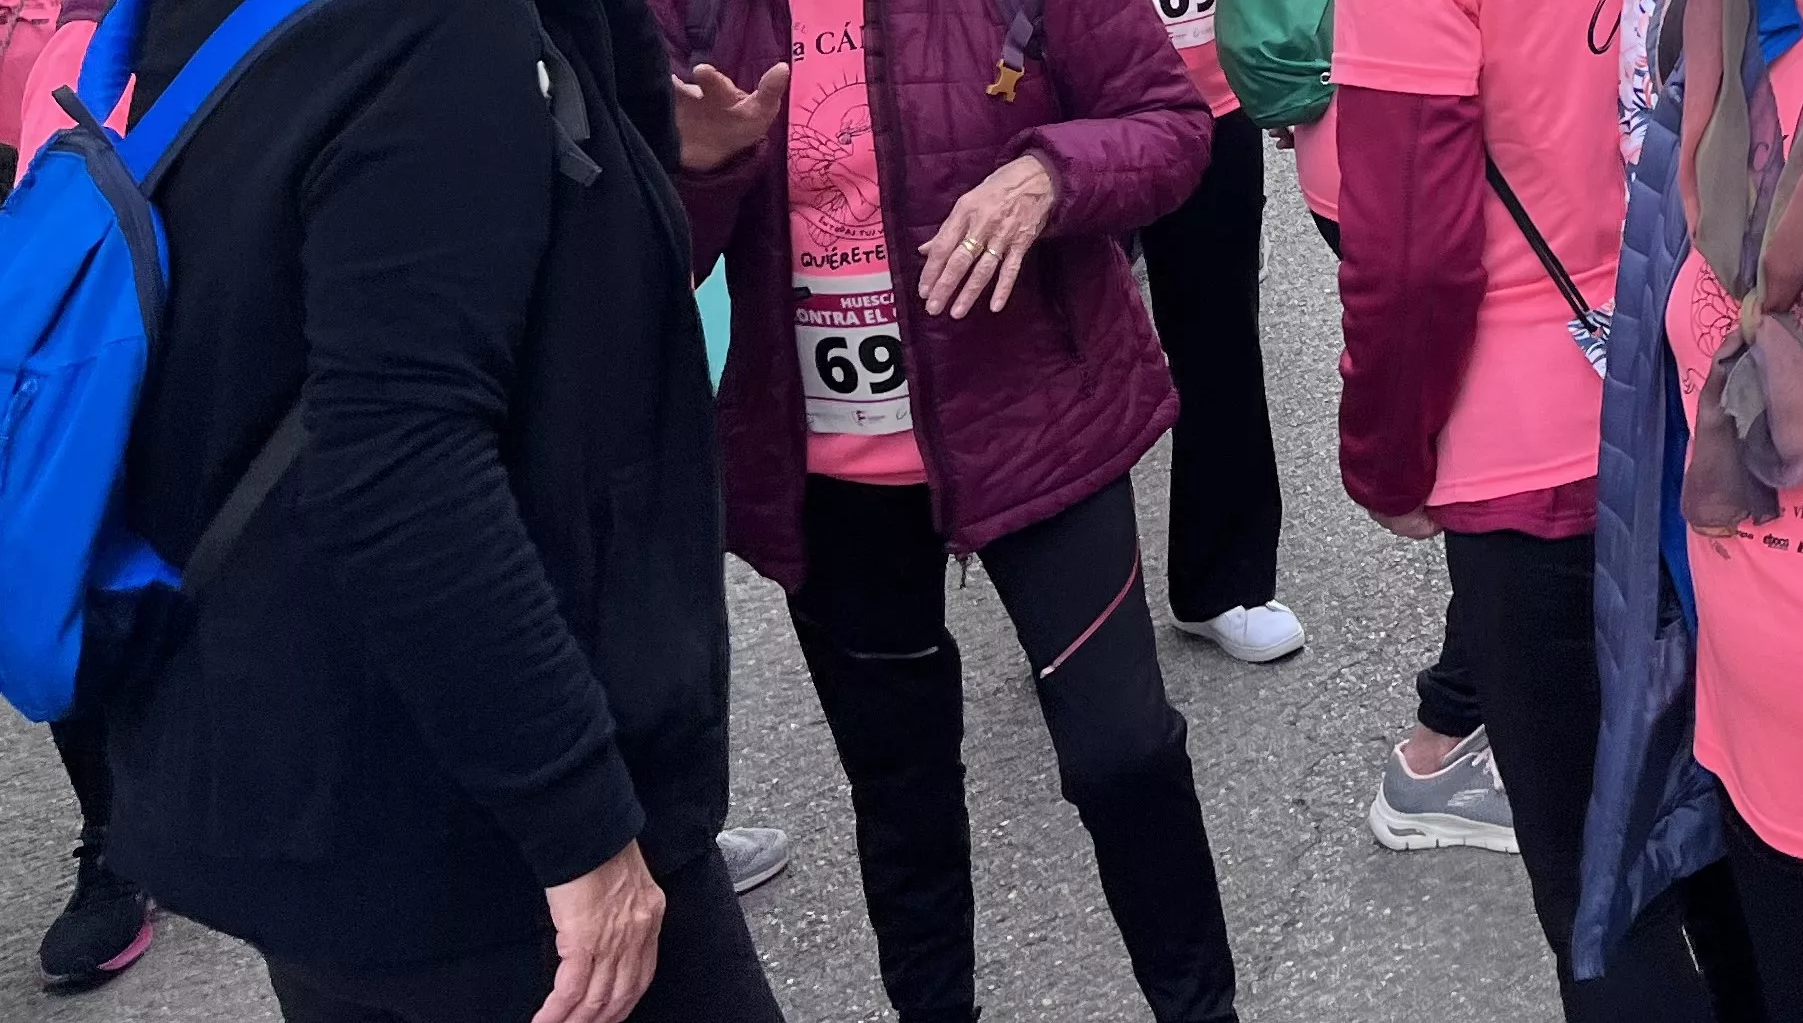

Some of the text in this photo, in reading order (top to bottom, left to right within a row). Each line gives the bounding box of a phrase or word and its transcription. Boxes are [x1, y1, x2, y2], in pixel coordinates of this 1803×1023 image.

[800, 244, 886, 271] QUIÉRETE
[795, 307, 888, 326] ONTRA EL
